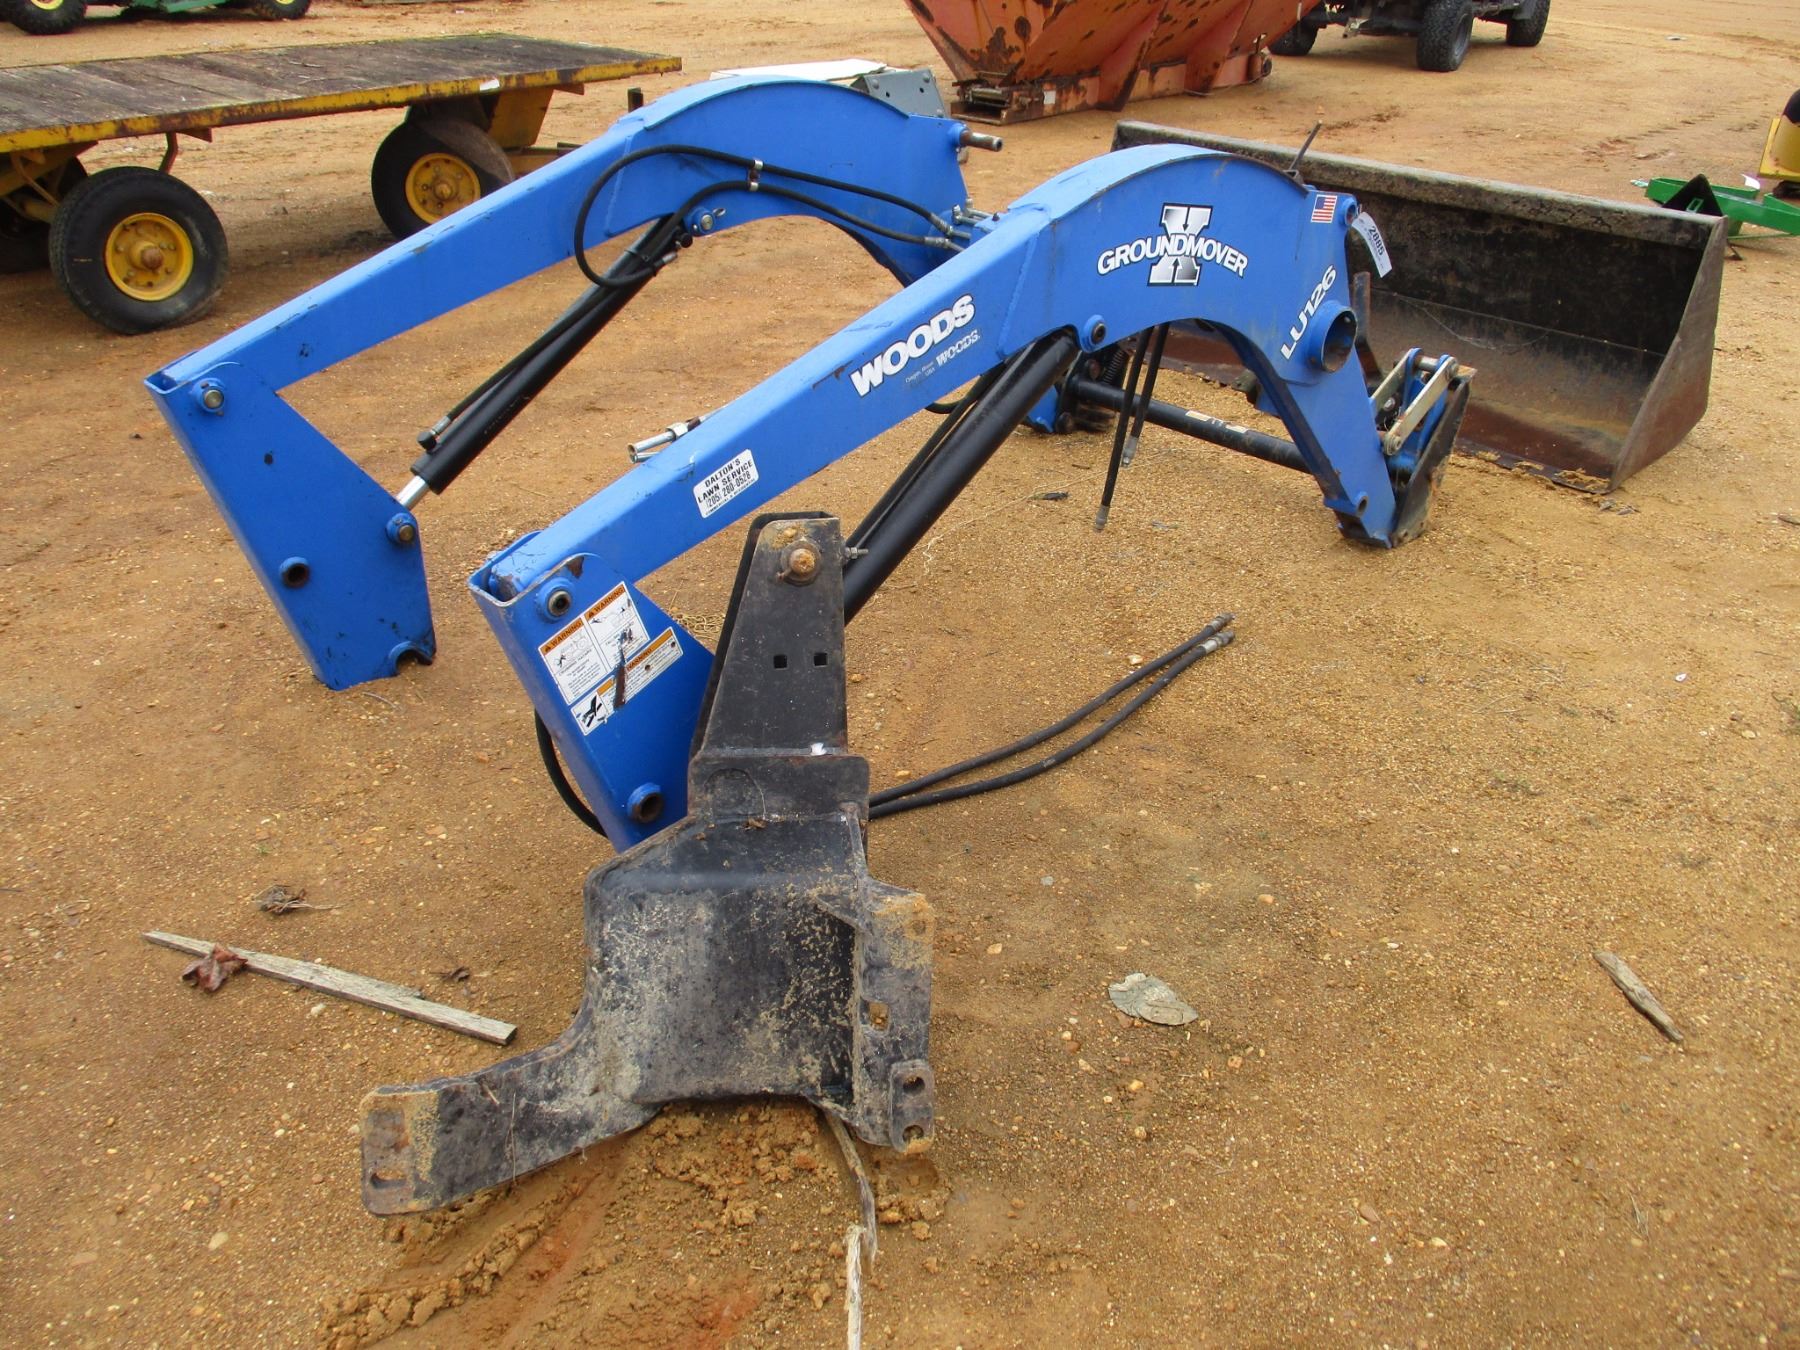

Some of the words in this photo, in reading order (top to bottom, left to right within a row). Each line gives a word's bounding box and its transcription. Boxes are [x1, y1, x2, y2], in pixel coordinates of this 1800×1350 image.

[1097, 233, 1248, 278] GROUNDMOVER
[1368, 226, 1384, 256] 2885
[1280, 265, 1337, 360] LU126
[849, 294, 976, 397] WOODS
[697, 484, 720, 503] LAWN
[721, 460, 753, 486] SERVICE
[704, 458, 741, 488] DALTON'S
[594, 587, 624, 613] WARNING
[551, 620, 582, 647] WARNING
